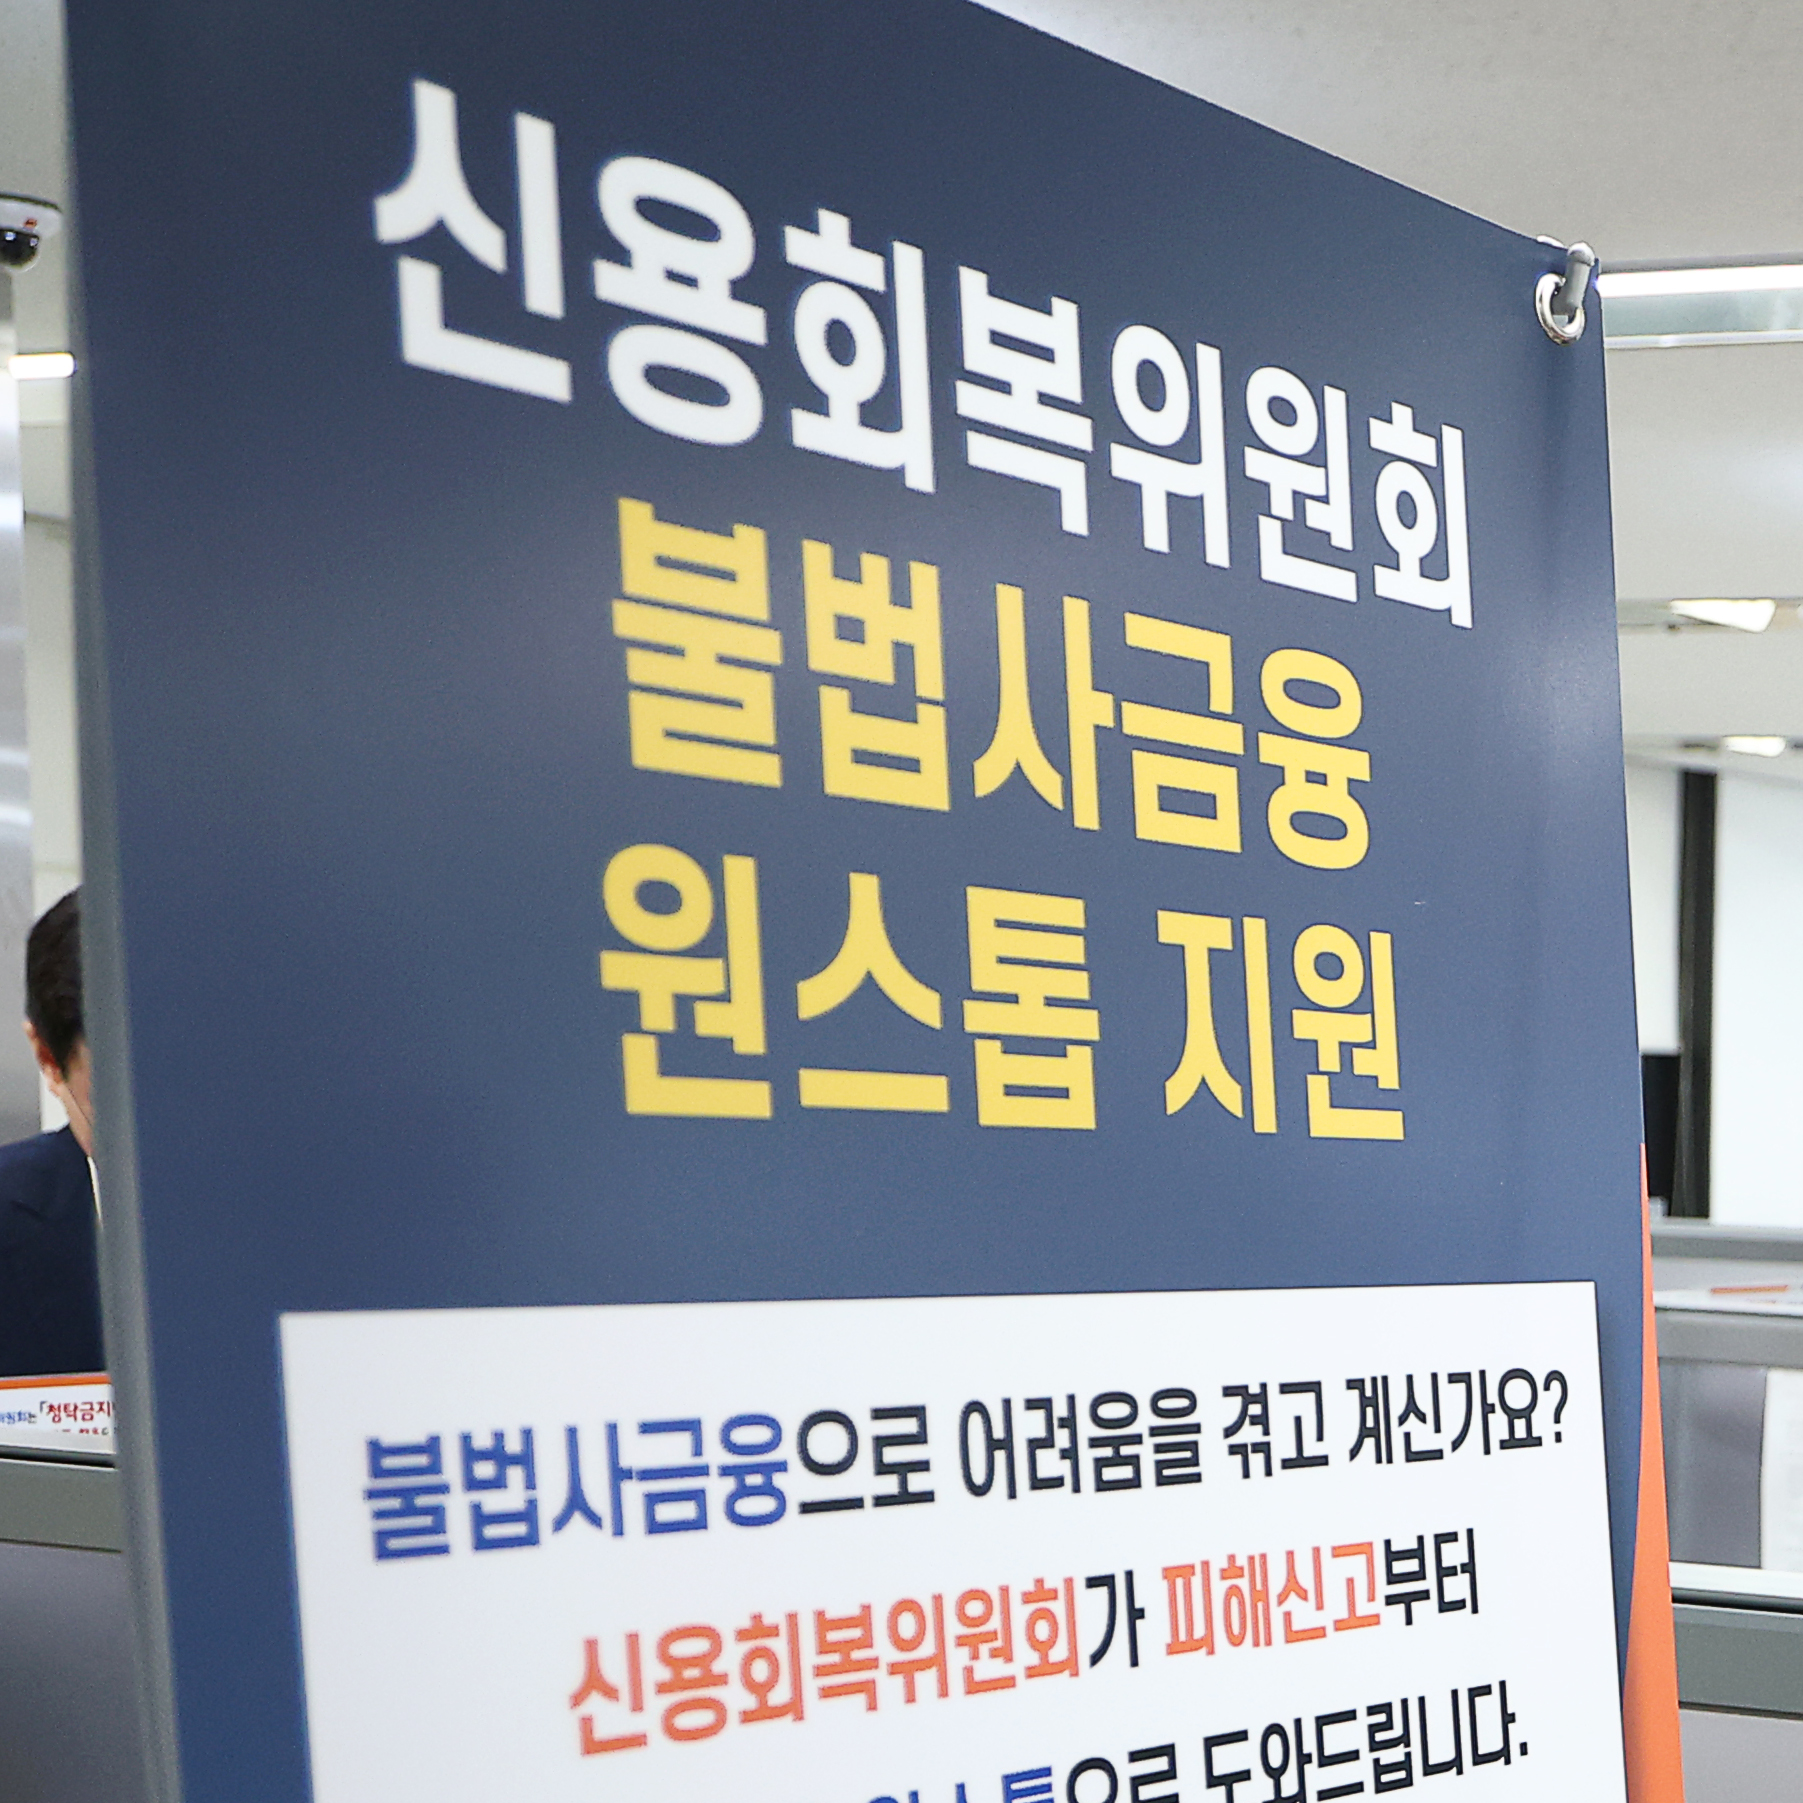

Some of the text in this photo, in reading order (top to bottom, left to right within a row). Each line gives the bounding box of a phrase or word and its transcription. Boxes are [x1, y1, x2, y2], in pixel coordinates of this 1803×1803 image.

[373, 79, 1475, 630] 신용회복위원회
[612, 496, 1371, 870] 불법사금융
[599, 844, 1406, 1140] 원스톱 지원
[40, 1400, 115, 1424] 「청탁금지
[363, 1368, 1568, 1562] 불법사금융으로 어려움을 겪고 계신가요?
[570, 1528, 1480, 1756] 신용회복위원회가 피해신고부터
